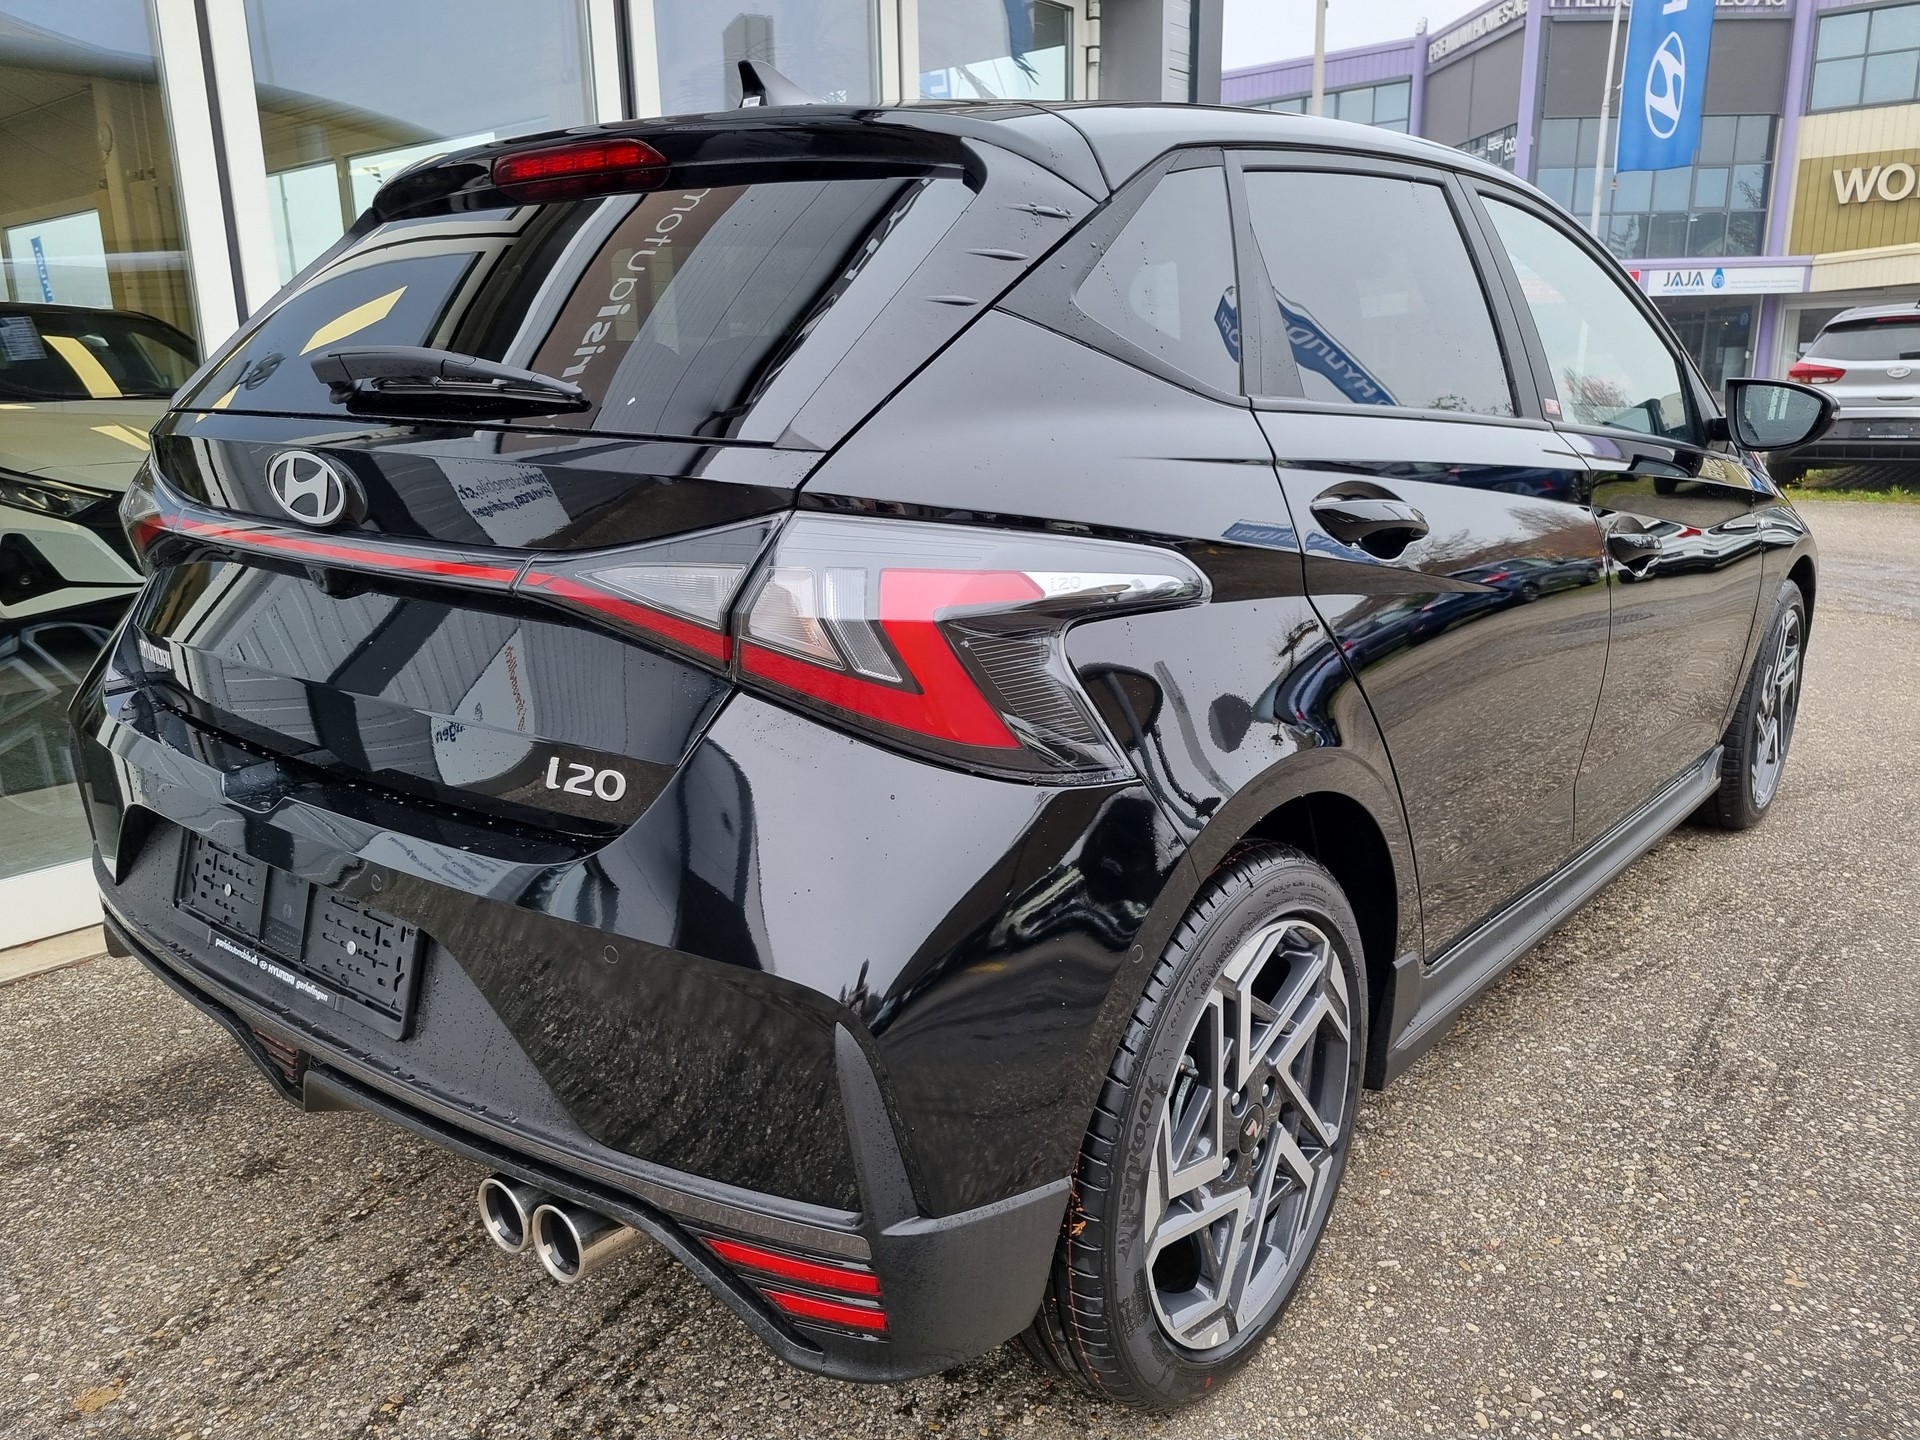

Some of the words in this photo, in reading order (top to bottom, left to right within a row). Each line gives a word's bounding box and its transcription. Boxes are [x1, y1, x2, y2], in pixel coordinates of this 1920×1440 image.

[1833, 162, 1920, 205] WO
[1663, 271, 1705, 287] JAJA
[268, 963, 296, 986] HYUNDAI
